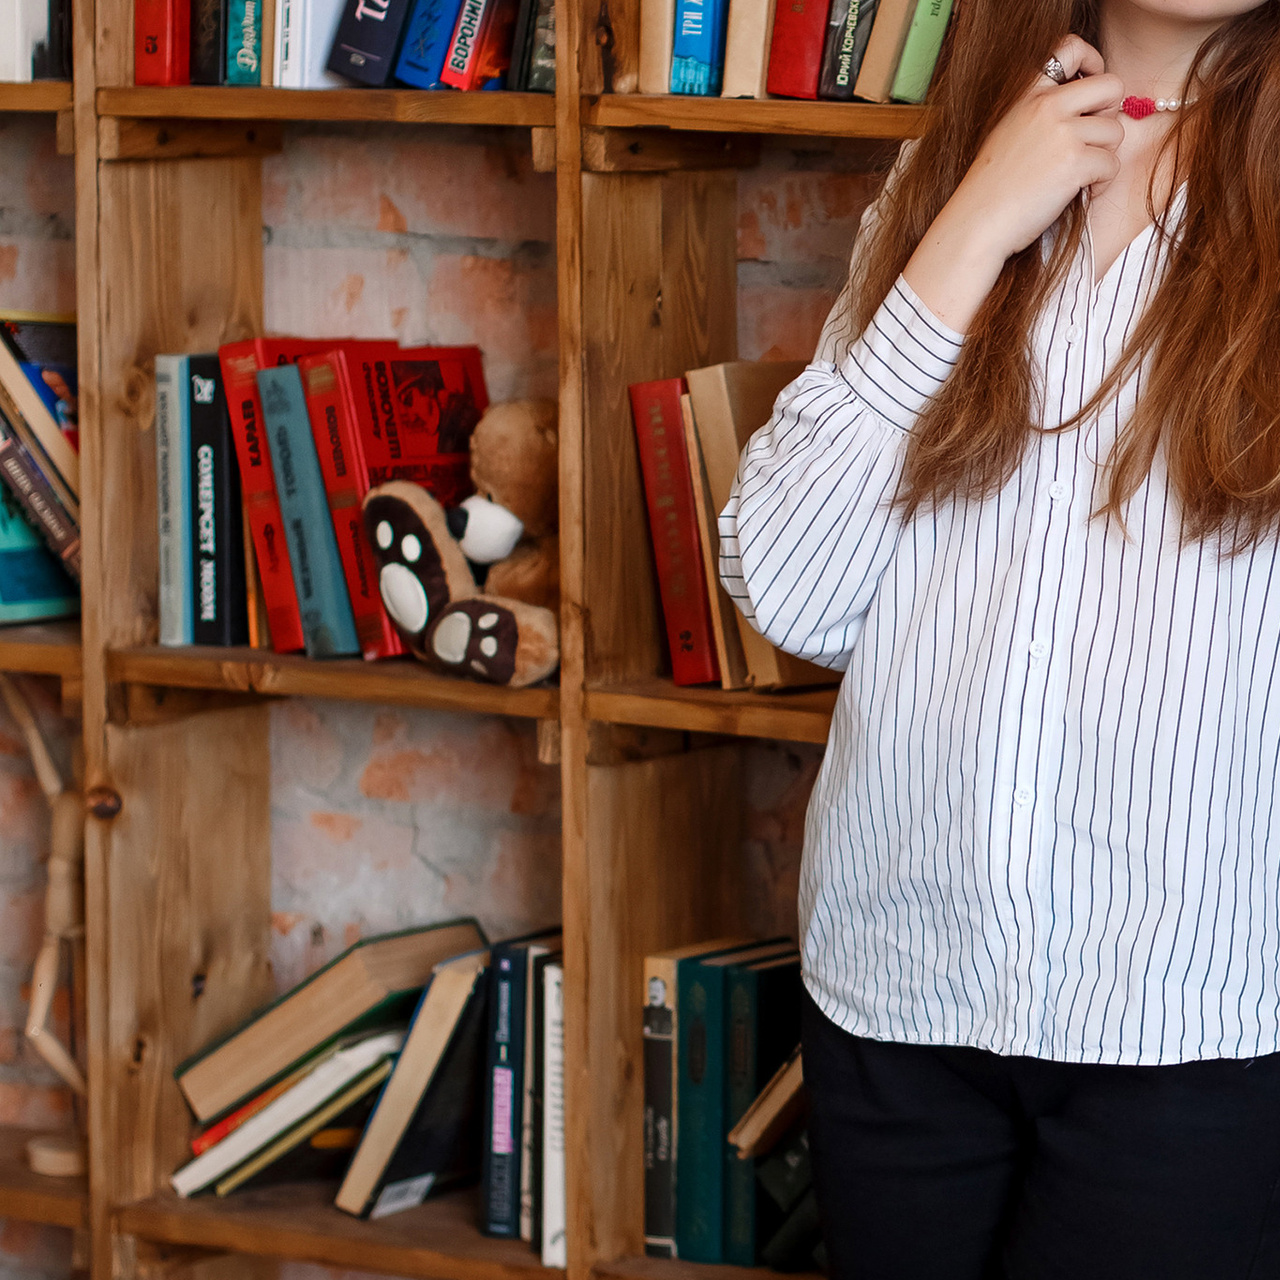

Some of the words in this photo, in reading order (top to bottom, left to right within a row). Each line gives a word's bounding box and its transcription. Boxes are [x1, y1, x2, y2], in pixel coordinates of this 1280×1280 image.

[682, 11, 702, 36] ТРИ
[836, 44, 852, 86] ЮРИЙ
[241, 400, 262, 467] КАРАЕВ
